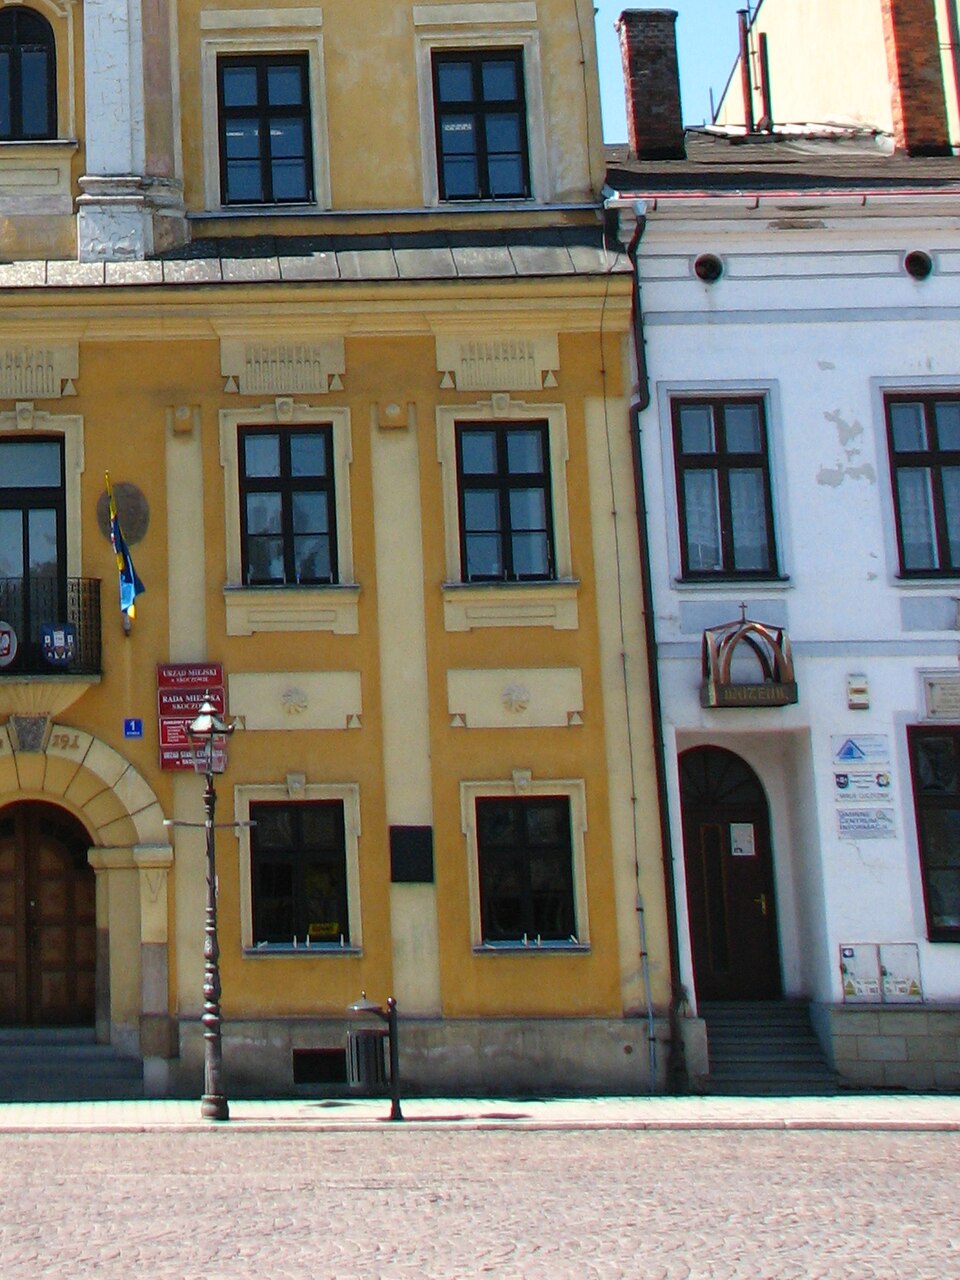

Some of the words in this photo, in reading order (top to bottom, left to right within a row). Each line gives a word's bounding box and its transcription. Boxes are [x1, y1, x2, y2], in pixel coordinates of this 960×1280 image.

[187, 668, 217, 677] MIEJSKI
[162, 695, 184, 703] RADA
[185, 694, 221, 702] MIEJKA
[129, 720, 135, 731] 1
